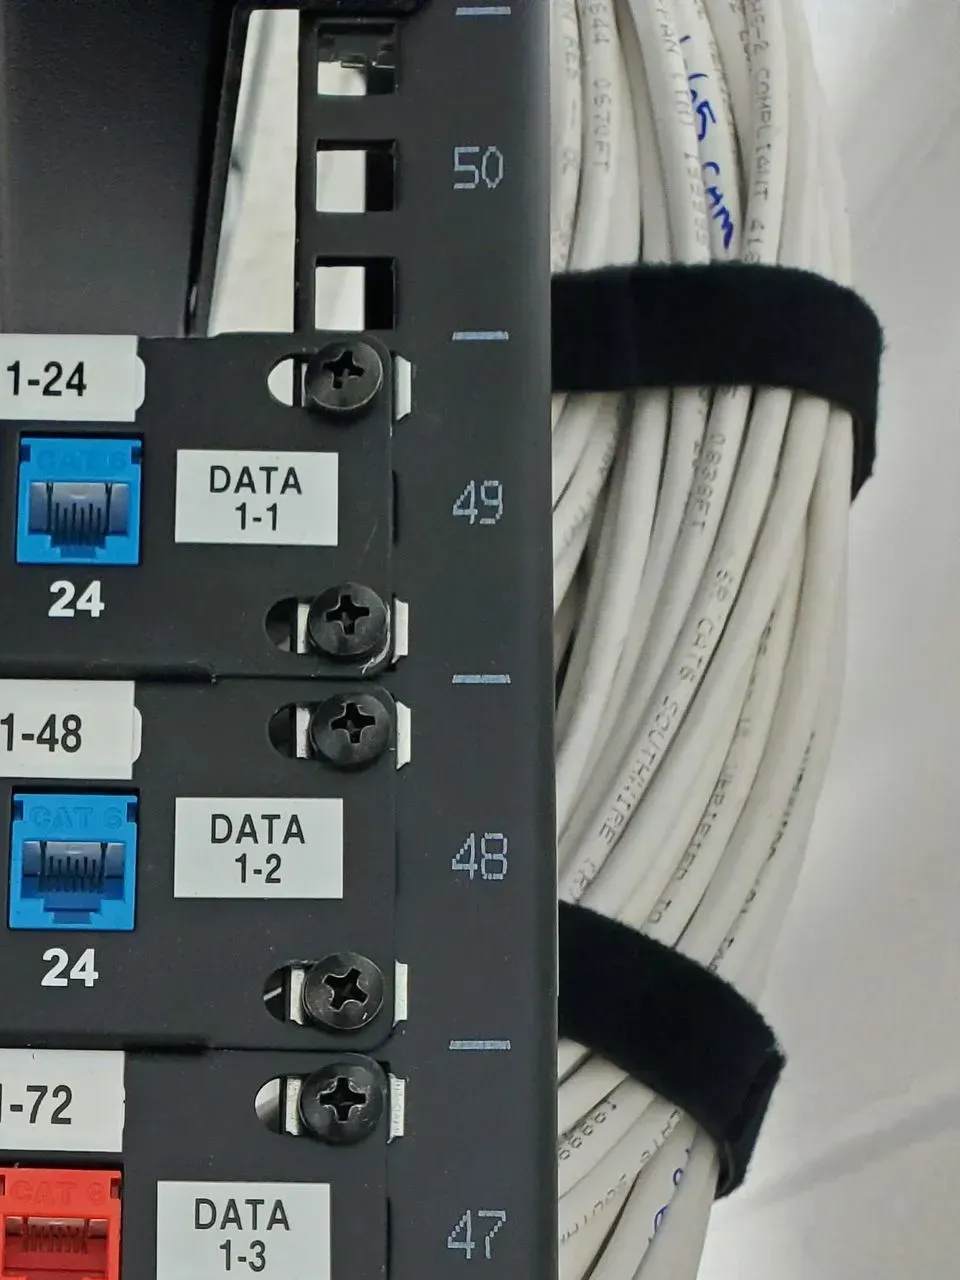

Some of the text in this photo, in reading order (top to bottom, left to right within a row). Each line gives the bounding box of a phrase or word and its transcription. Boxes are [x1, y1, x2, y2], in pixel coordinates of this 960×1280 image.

[453, 145, 504, 190] 50
[6, 360, 87, 397] 1-24
[209, 465, 302, 495] DATA
[235, 502, 278, 531] 1-1
[452, 479, 504, 525] 49
[47, 579, 105, 618] 24
[0, 712, 82, 753] 1-48
[28, 806, 92, 830] CAT
[210, 813, 306, 845] DATA
[234, 852, 282, 884] 1-2
[451, 832, 508, 880] 48
[40, 947, 99, 987] 24
[194, 1197, 290, 1231] DATA
[447, 1209, 507, 1260] 47
[219, 1239, 266, 1273] 1-3
